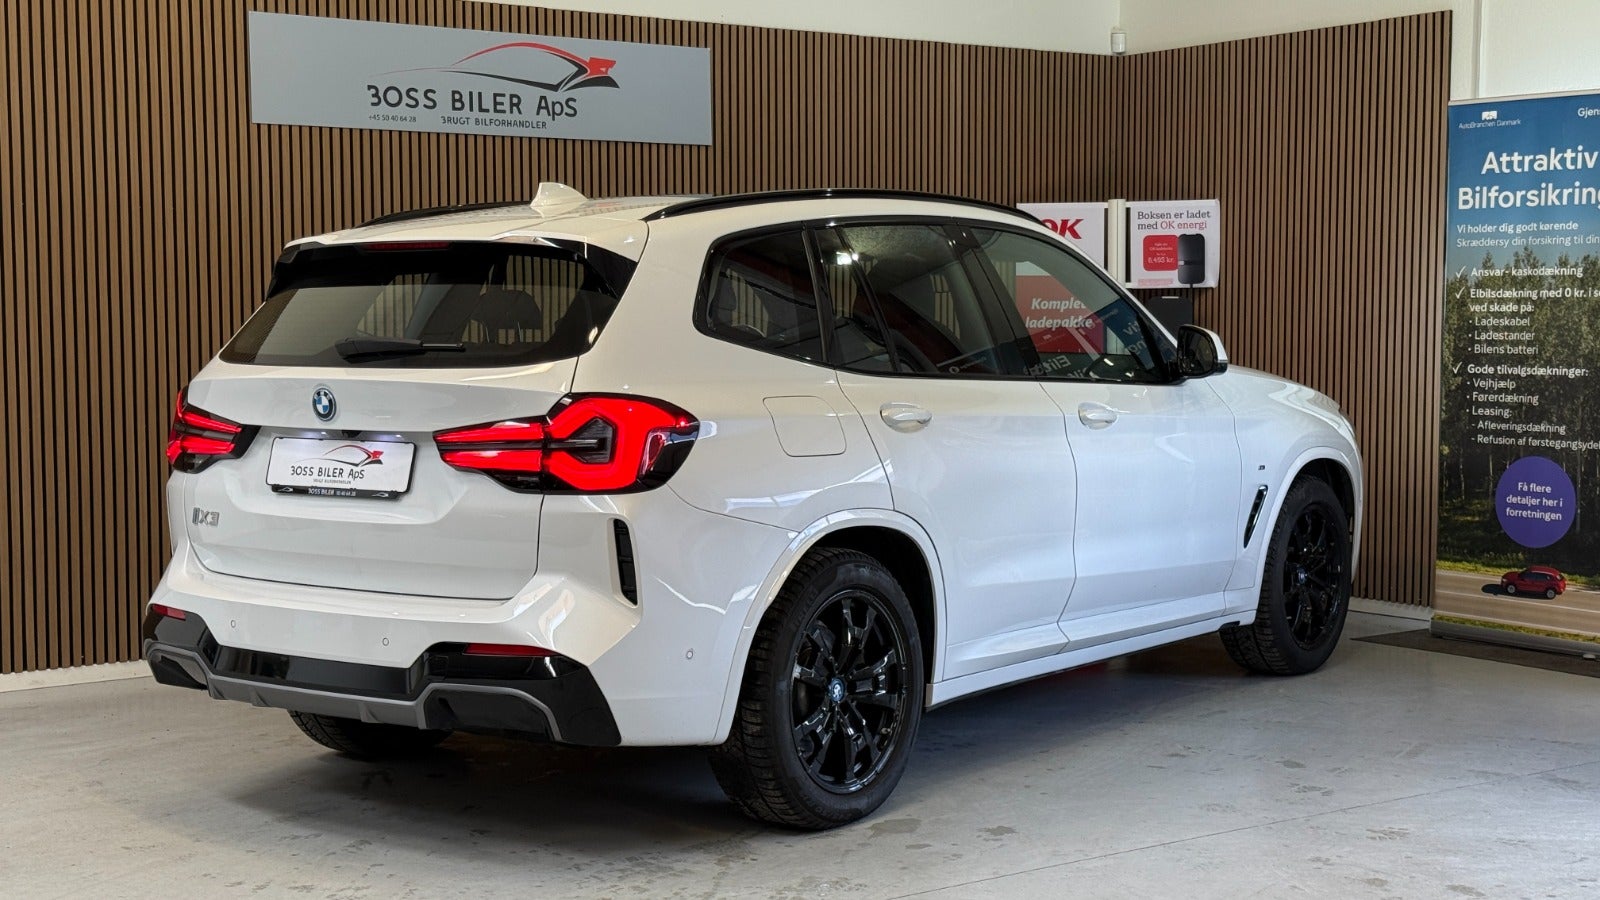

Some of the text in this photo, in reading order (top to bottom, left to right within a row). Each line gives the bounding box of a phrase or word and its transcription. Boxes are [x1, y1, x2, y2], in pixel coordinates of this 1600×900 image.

[367, 84, 578, 121] BOSS BILER ApS
[475, 118, 547, 129] BILFORHANDLER
[1497, 119, 1521, 128] Danmark
[1481, 144, 1599, 175] Attraktiv
[1137, 211, 1172, 220] Boksen
[1186, 210, 1211, 219] ladet
[1137, 221, 1207, 231] med OK energi
[1456, 221, 1579, 234] Vi holder dig godt kørende
[1456, 237, 1509, 248] Skræddersy
[1511, 236, 1526, 246] din
[1528, 235, 1571, 247] forsikring
[1574, 234, 1583, 244] til
[1511, 265, 1583, 278] kaskodækning
[1470, 288, 1538, 300] Elbilsdækning
[1540, 287, 1562, 298] med
[1564, 287, 1572, 298] 0
[1574, 287, 1587, 298] kr.
[1470, 302, 1535, 314] ved skade på:
[1025, 316, 1093, 331] ladepakke
[1475, 316, 1530, 326] Ladeskabel
[1474, 330, 1535, 340] Ladestander
[1474, 343, 1539, 355] Bilens batteri
[1467, 364, 1589, 379] Gode tilvalgsdækninger:
[1472, 377, 1516, 390] Vejhjælp
[1472, 391, 1539, 406] Førerdækning
[1472, 405, 1513, 419] Leasing:
[1477, 420, 1567, 436] Afleveringsdækning
[1477, 434, 1516, 445] Refusion
[1517, 436, 1527, 446] af
[317, 466, 344, 479] BILER
[347, 468, 365, 481] ApS
[1517, 481, 1552, 494] Få flere
[1506, 494, 1541, 507] detaljer
[1542, 497, 1558, 507] her
[1506, 507, 1562, 522] forretningen
